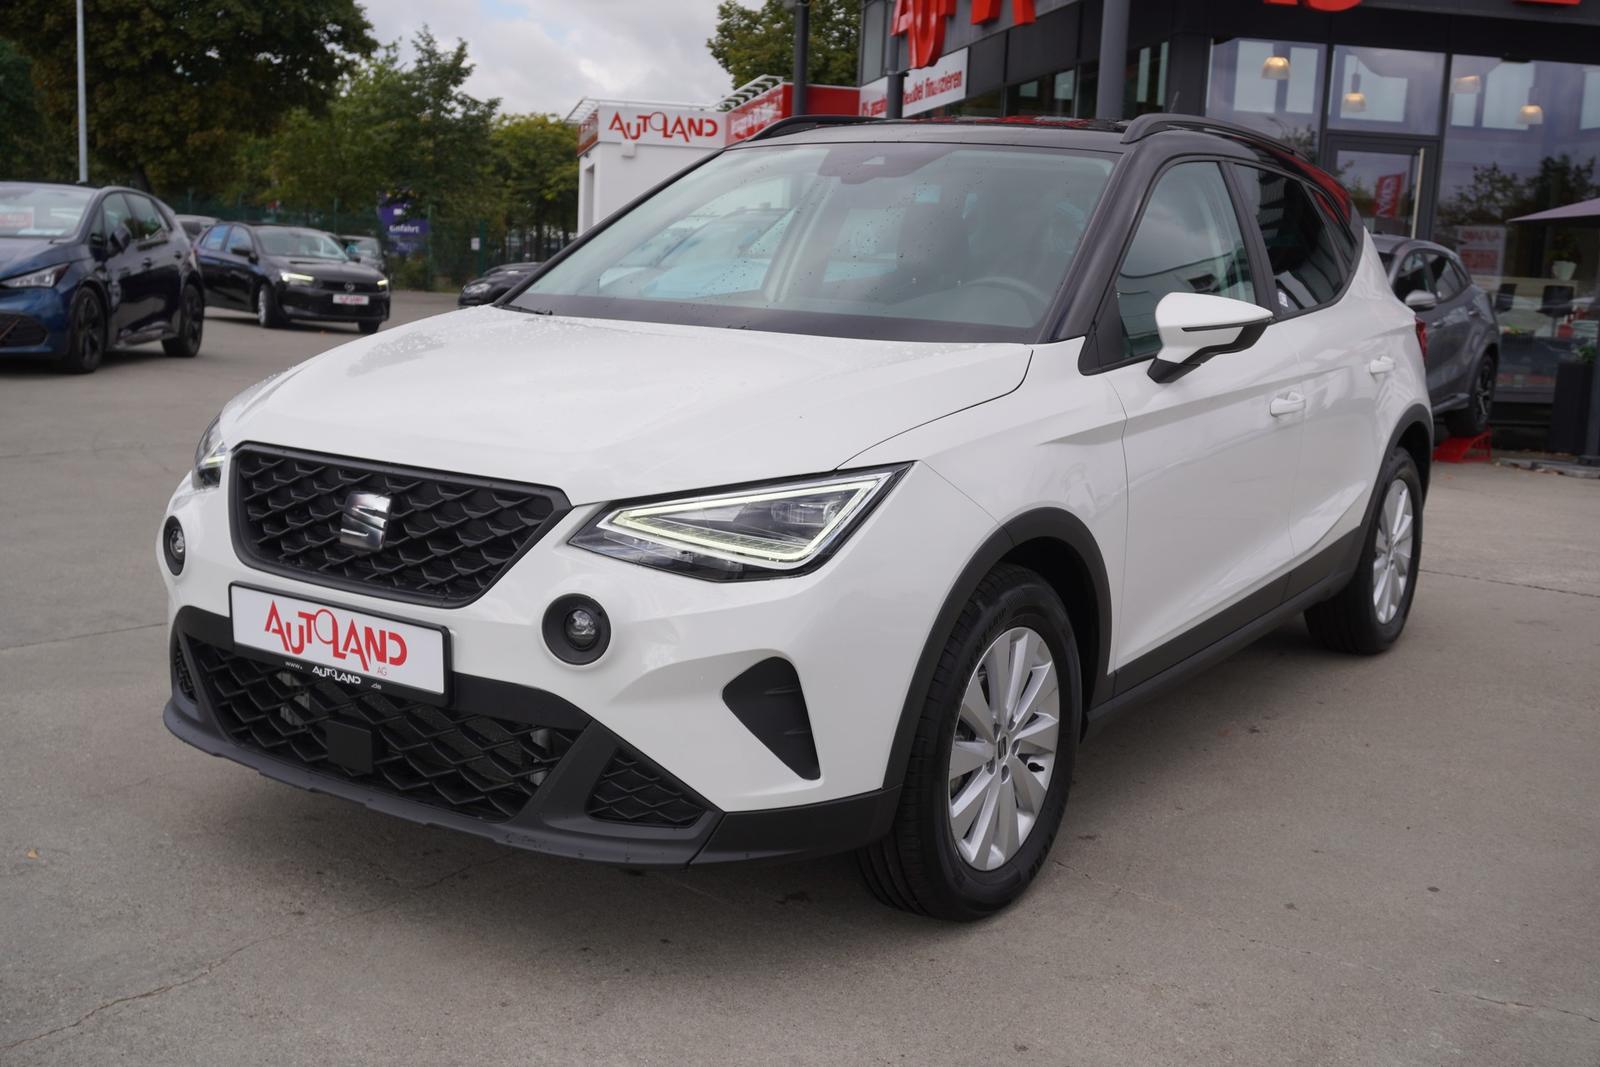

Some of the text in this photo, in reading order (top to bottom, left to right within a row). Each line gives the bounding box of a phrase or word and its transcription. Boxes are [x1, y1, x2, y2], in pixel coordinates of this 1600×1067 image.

[609, 111, 719, 142] AUTOLAND
[264, 600, 408, 672] AUTOLAND
[312, 665, 361, 684] AUTOLAND
[377, 665, 388, 677] AG
